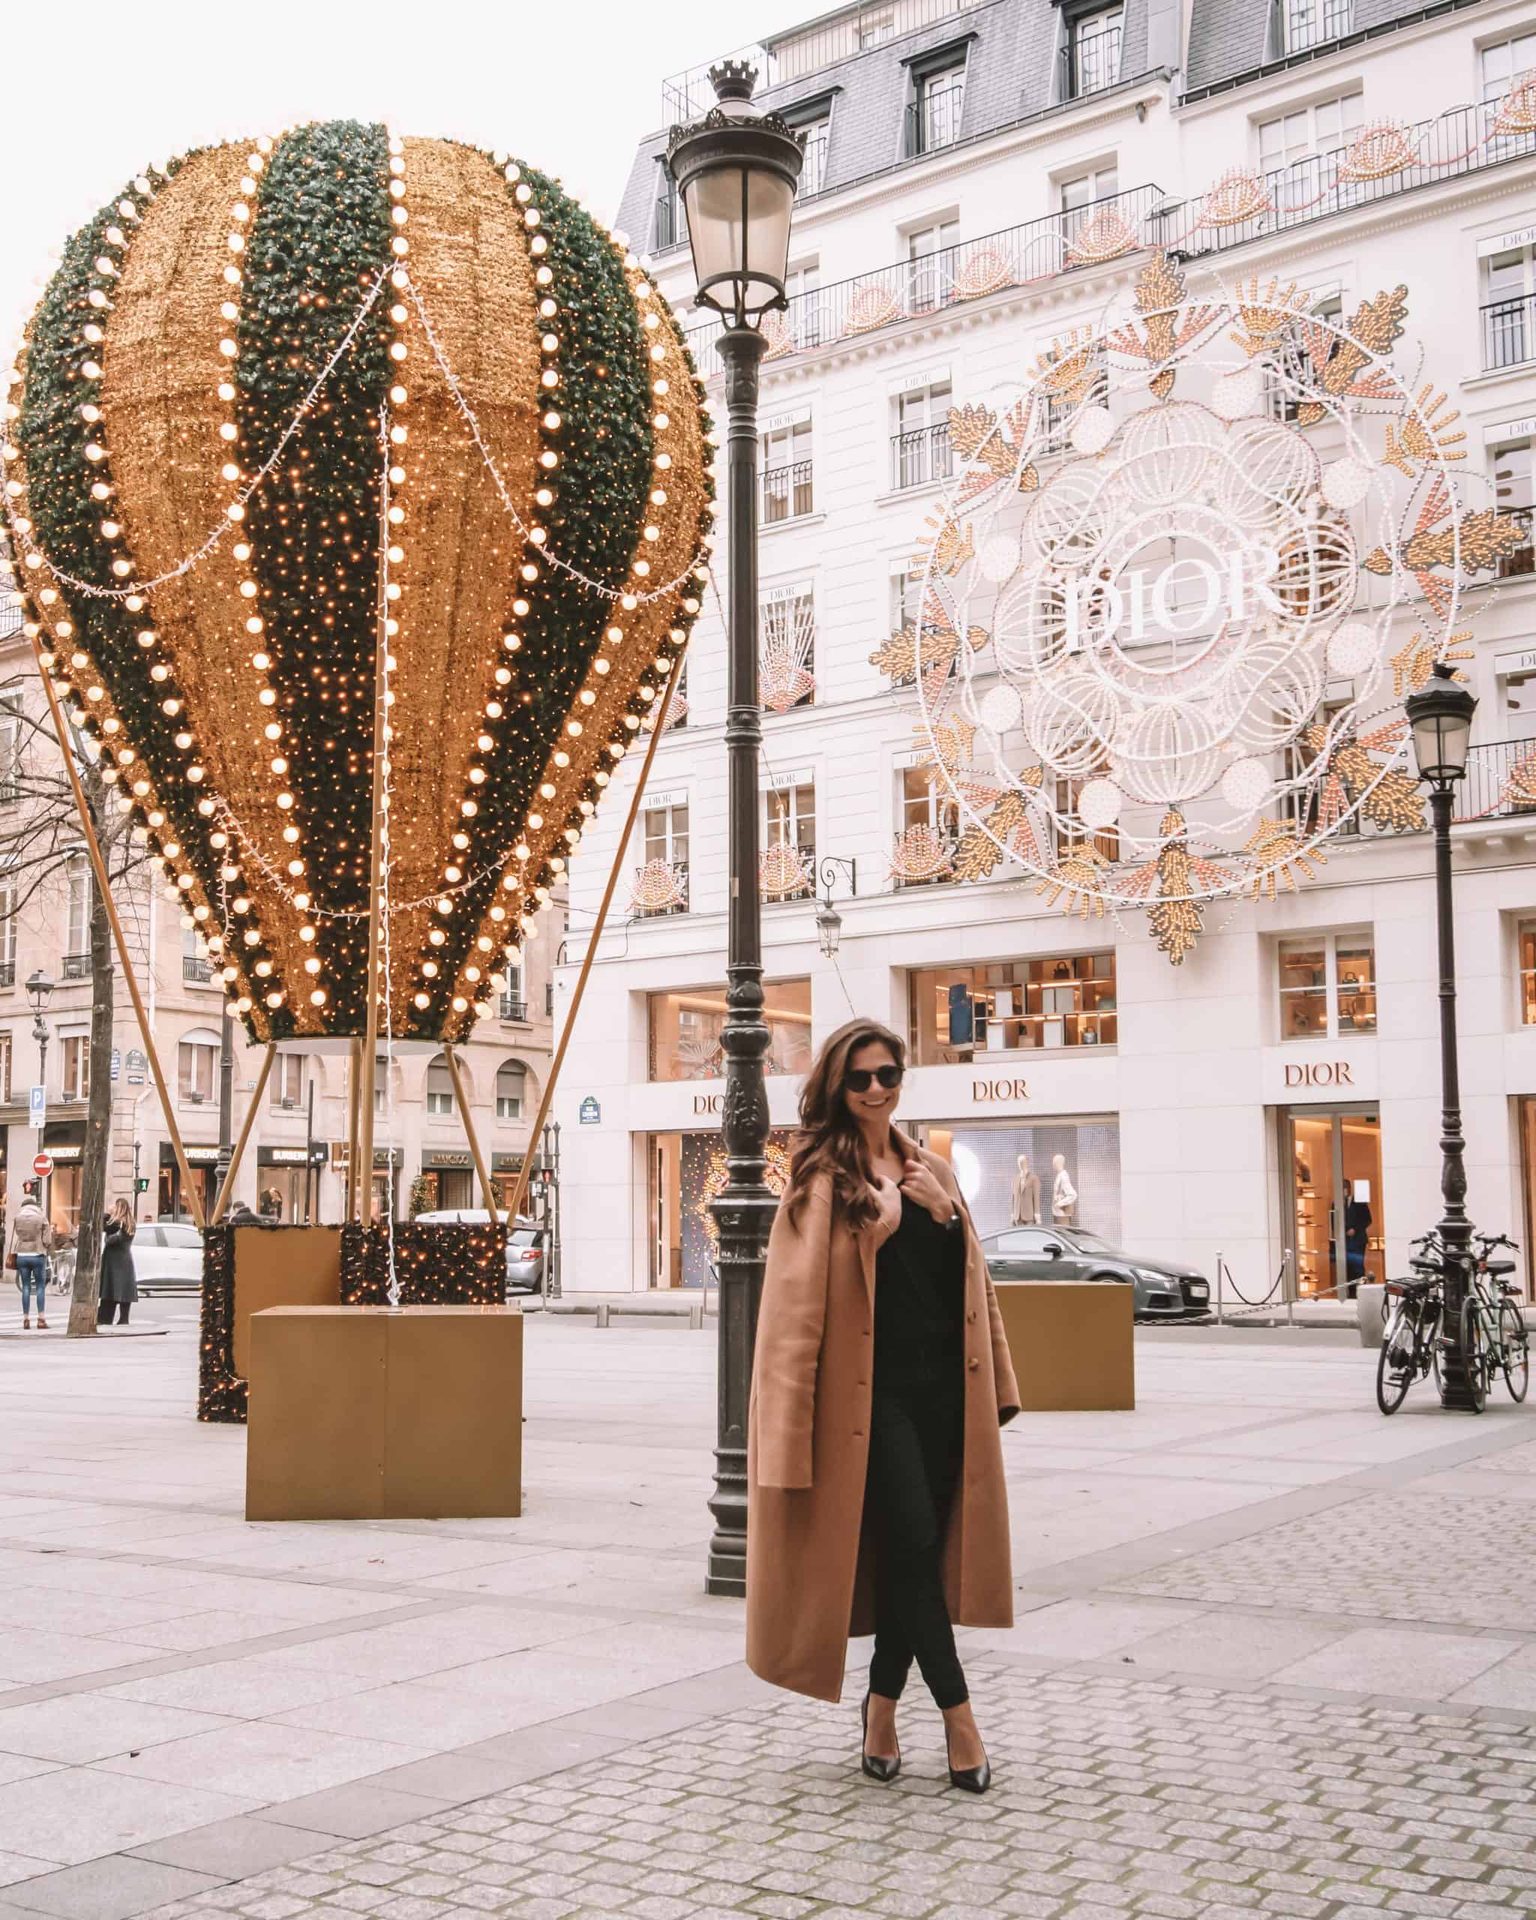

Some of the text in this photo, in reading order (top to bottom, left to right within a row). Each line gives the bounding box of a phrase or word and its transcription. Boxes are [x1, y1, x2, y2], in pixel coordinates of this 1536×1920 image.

[1509, 421, 1536, 435] DIO
[770, 586, 796, 601] DIOR
[1065, 545, 1294, 653] DIOR
[1521, 653, 1536, 667] DI
[649, 793, 672, 806] DIOR
[1284, 1062, 1355, 1087] DIOR
[972, 1078, 1031, 1101] DIOR
[693, 1094, 725, 1114] DIO
[183, 1148, 220, 1159] URBERR
[272, 1149, 309, 1161] BURBERR
